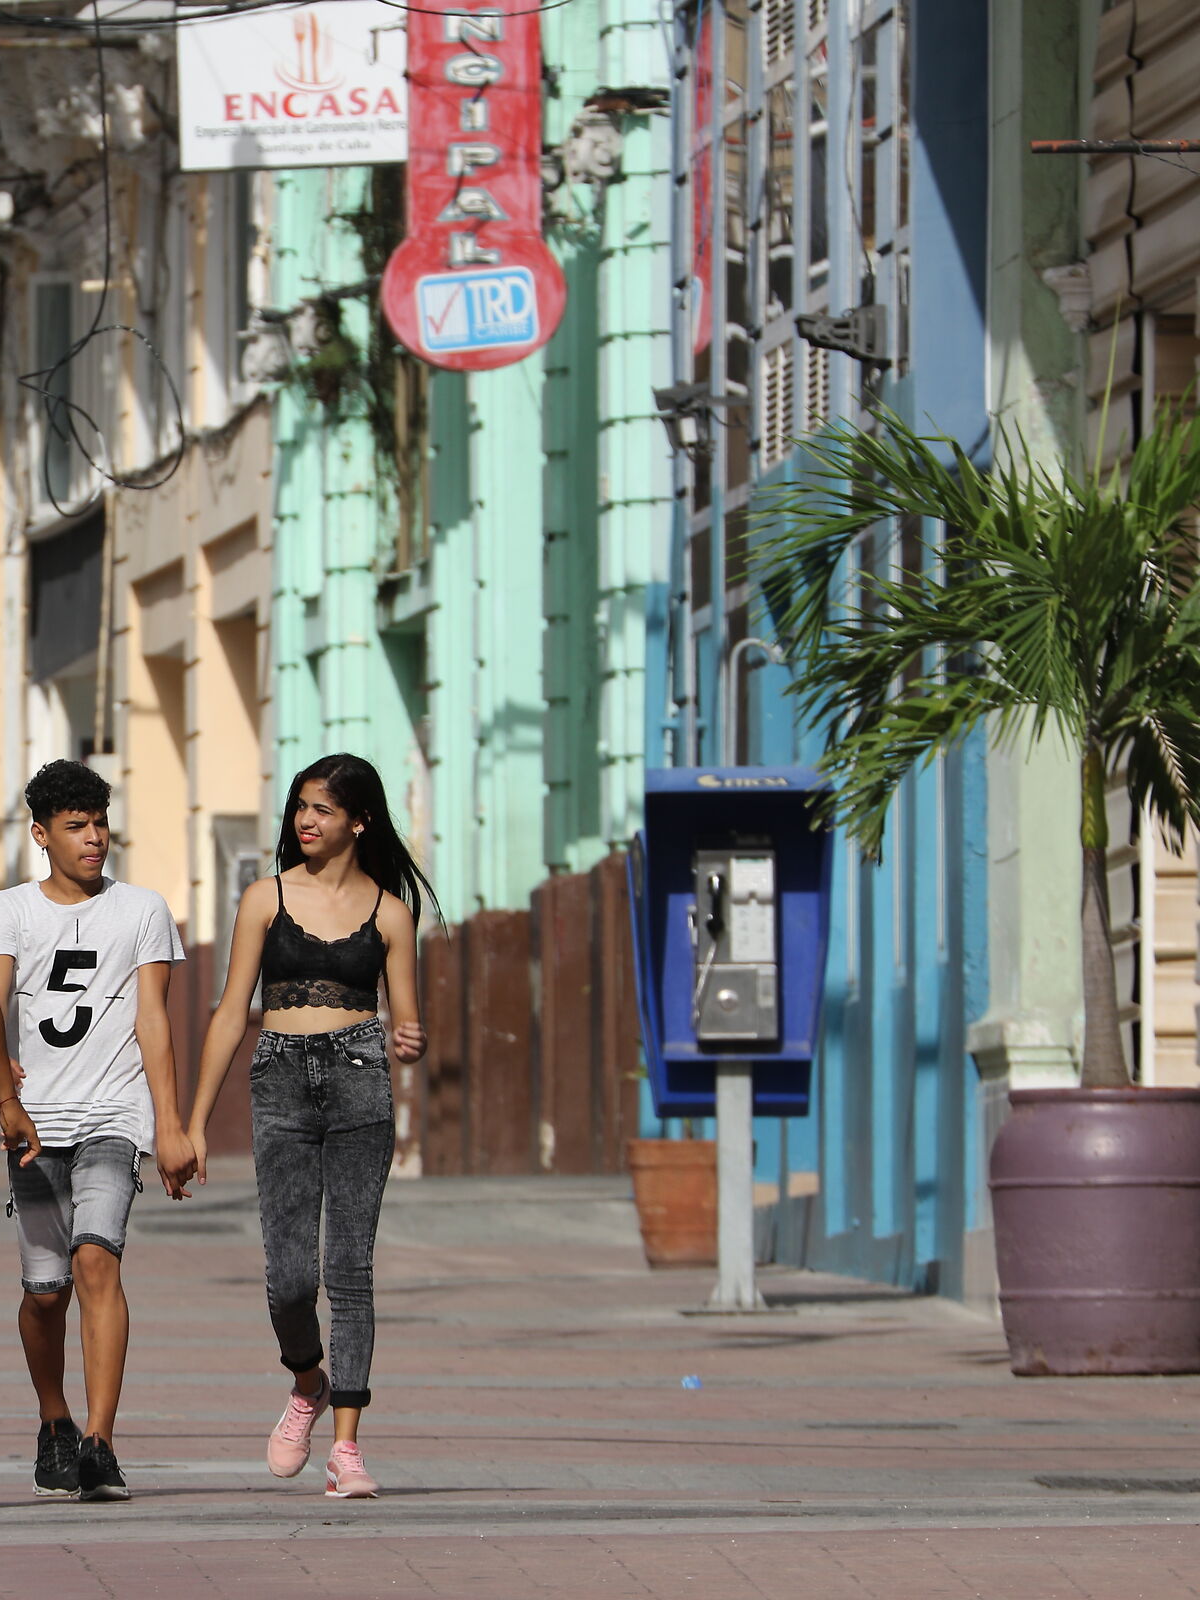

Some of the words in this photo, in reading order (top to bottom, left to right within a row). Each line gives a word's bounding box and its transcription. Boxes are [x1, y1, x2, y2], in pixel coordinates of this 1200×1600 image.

[223, 86, 402, 122] ENCASA
[318, 140, 332, 151] de
[467, 276, 532, 326] TRD
[38, 949, 98, 1049] 5
